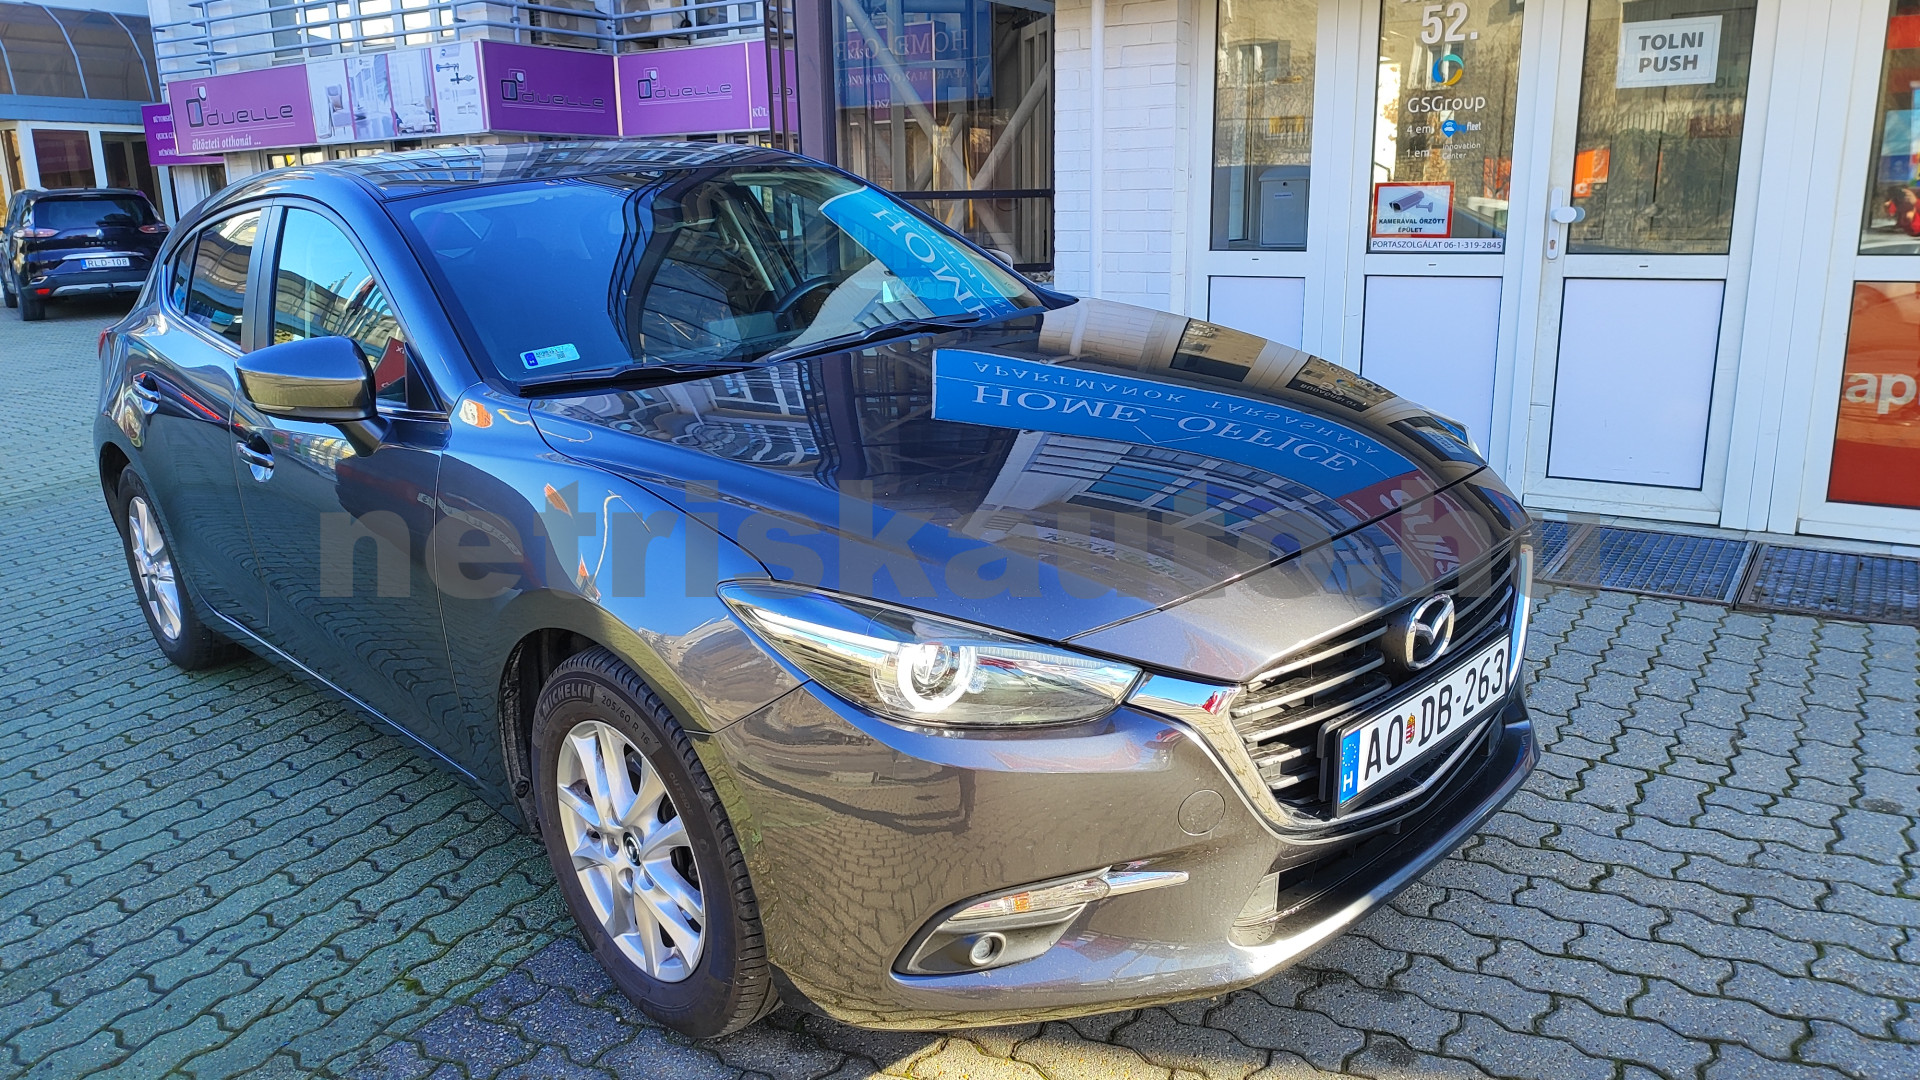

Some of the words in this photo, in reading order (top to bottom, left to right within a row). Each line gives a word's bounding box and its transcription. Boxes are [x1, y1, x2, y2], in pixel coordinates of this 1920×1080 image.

[1420, 2, 1478, 44] 52.
[1638, 31, 1704, 52] TOLNI
[1638, 54, 1699, 73] PUSH
[1407, 95, 1486, 113] GSGroup
[192, 137, 220, 151] öltözteti
[221, 133, 252, 148] otthonát
[1379, 217, 1418, 225] KAMERÁVAL
[1372, 240, 1442, 249] PORTASZOLGÁLAT
[1443, 241, 1502, 249] 06-1-319-2845
[87, 258, 128, 267] RLD-108
[541, 683, 592, 716] MICHELIN
[601, 695, 631, 723] 205/60
[631, 723, 639, 732] R
[640, 731, 650, 745] 16
[1342, 776, 1353, 793] H
[1418, 648, 1505, 747] DB-263
